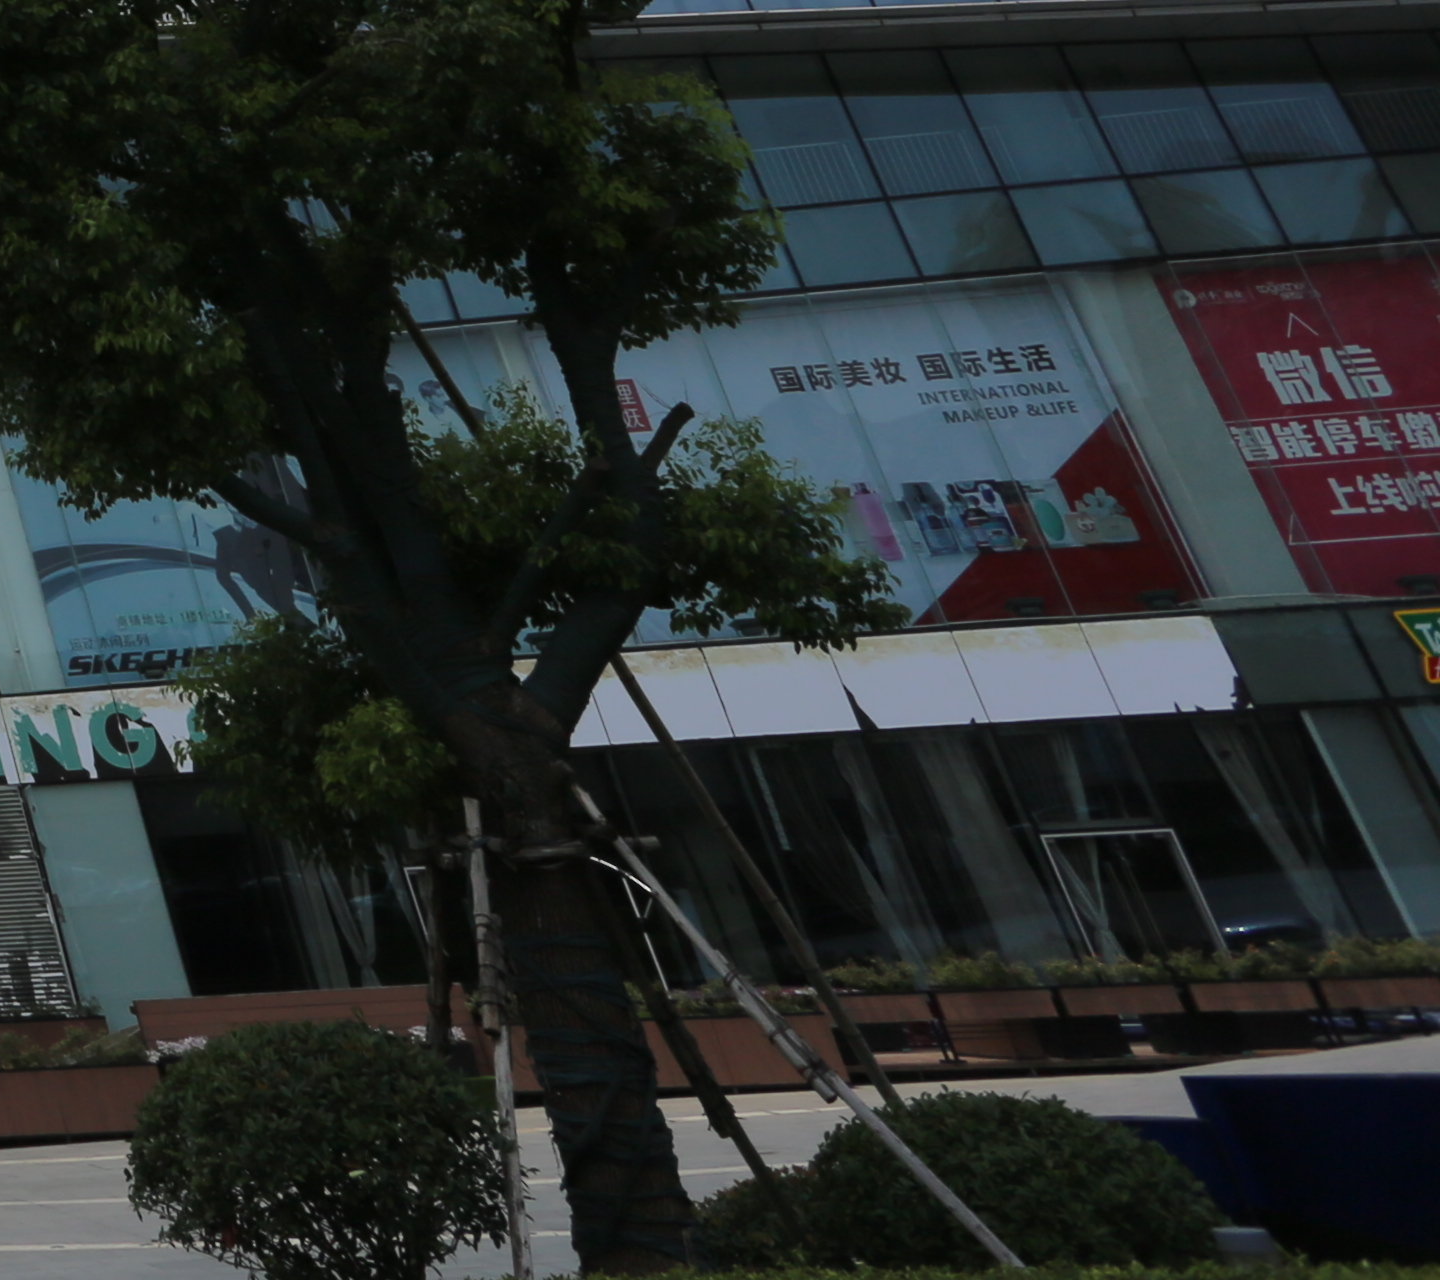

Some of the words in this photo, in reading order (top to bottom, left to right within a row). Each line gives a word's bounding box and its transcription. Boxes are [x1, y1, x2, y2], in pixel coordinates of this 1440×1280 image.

[769, 356, 907, 394] 国际美妆
[916, 343, 1057, 382] 国际生活
[918, 380, 1070, 405] INTERNATIONAL
[1256, 344, 1394, 406] 微信
[942, 406, 1019, 425] MAKEUP
[1230, 410, 1440, 462] 智能停车缴
